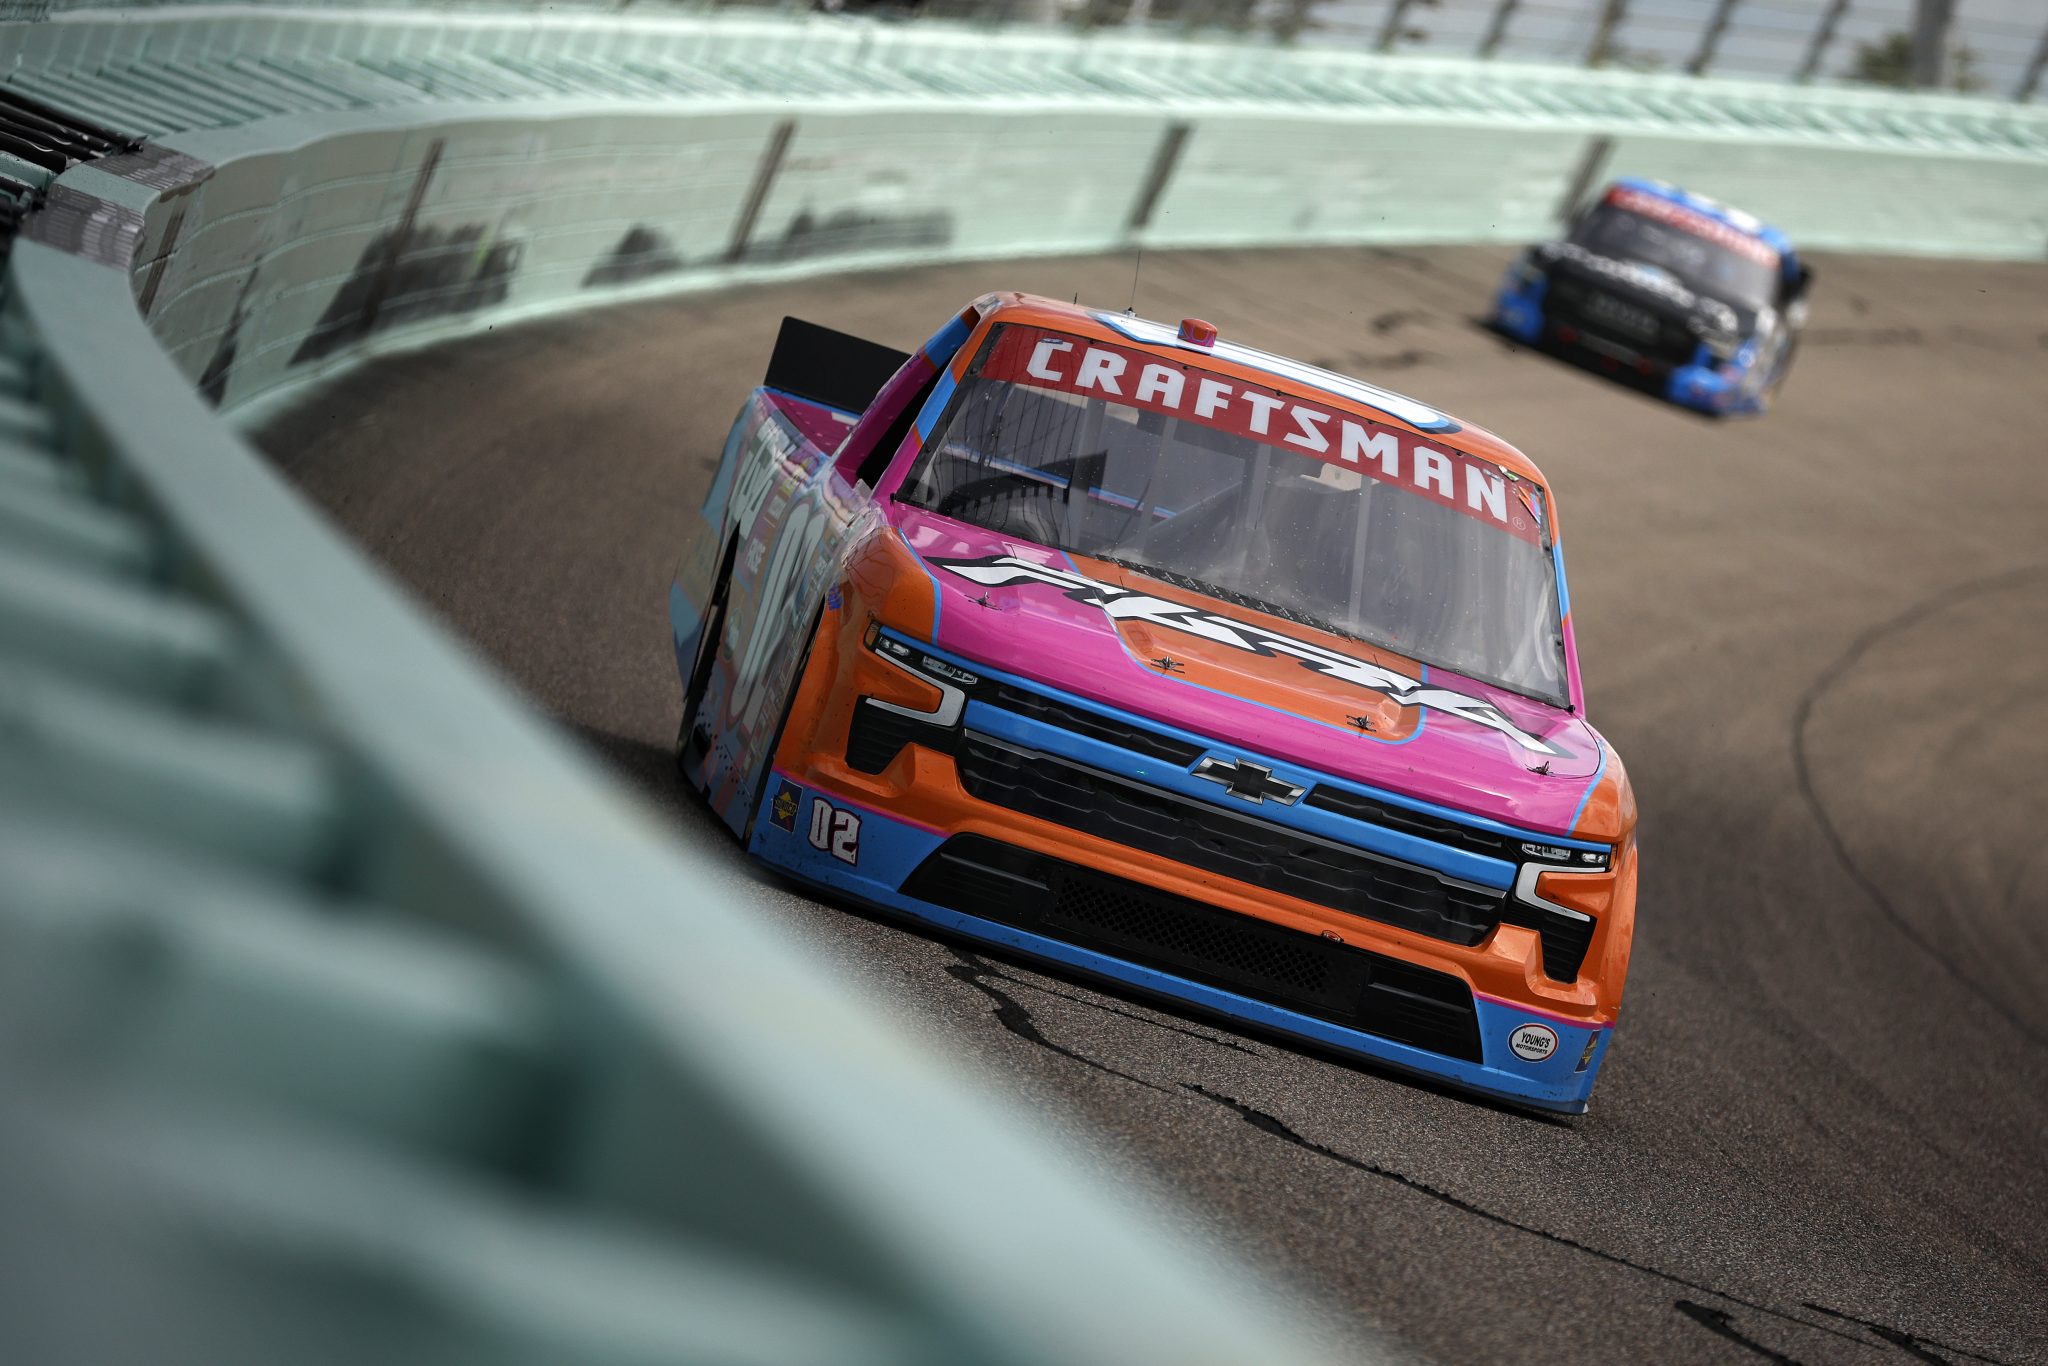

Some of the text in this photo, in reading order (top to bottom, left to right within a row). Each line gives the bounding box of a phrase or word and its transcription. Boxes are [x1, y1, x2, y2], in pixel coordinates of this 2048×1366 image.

[1026, 338, 1508, 524] CRAFTSMAN
[808, 796, 861, 866] 02
[1515, 1043, 1548, 1055] MOTORSPORTS
[1522, 1031, 1550, 1049] YOUNG'S
